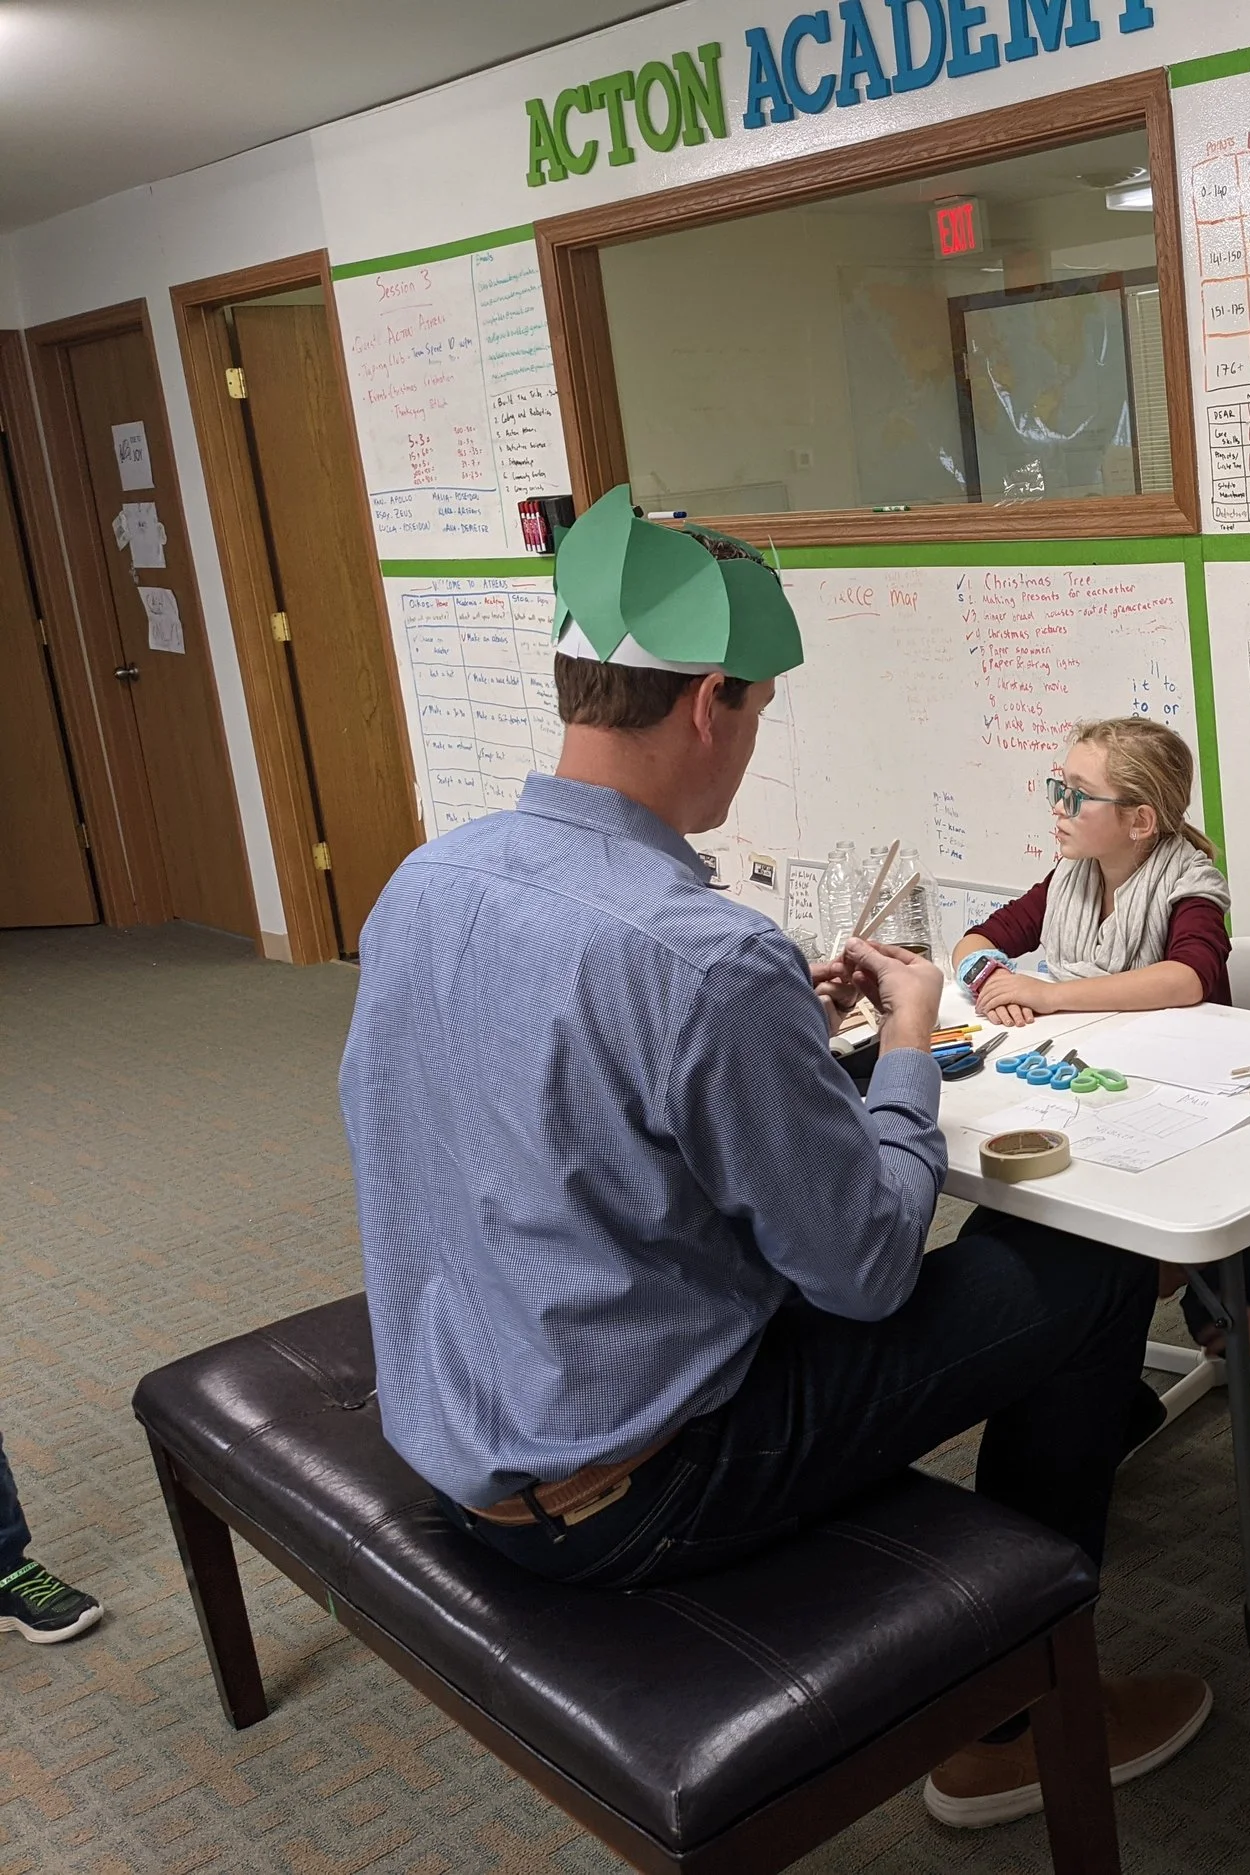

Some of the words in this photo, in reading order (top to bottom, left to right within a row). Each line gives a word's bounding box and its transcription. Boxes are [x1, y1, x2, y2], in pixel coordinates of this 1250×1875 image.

[526, 42, 728, 187] ACTON
[937, 203, 976, 256] EXIT
[375, 276, 416, 303] Session
[419, 268, 433, 290] 3
[1213, 409, 1236, 420] DEAR
[984, 572, 1051, 590] Christmas
[1063, 571, 1093, 586] Tree
[889, 588, 919, 612] Map
[982, 594, 1016, 608] Making
[1021, 590, 1060, 602] Presents
[1068, 587, 1081, 598] for
[1086, 583, 1136, 598] eachother
[987, 626, 1030, 640] Christmas
[1035, 625, 1068, 638] pictures
[988, 657, 1014, 673] Paper
[1163, 675, 1177, 692] to
[1003, 700, 1044, 716] cookies
[1132, 698, 1149, 712] to
[1163, 704, 1179, 715] or
